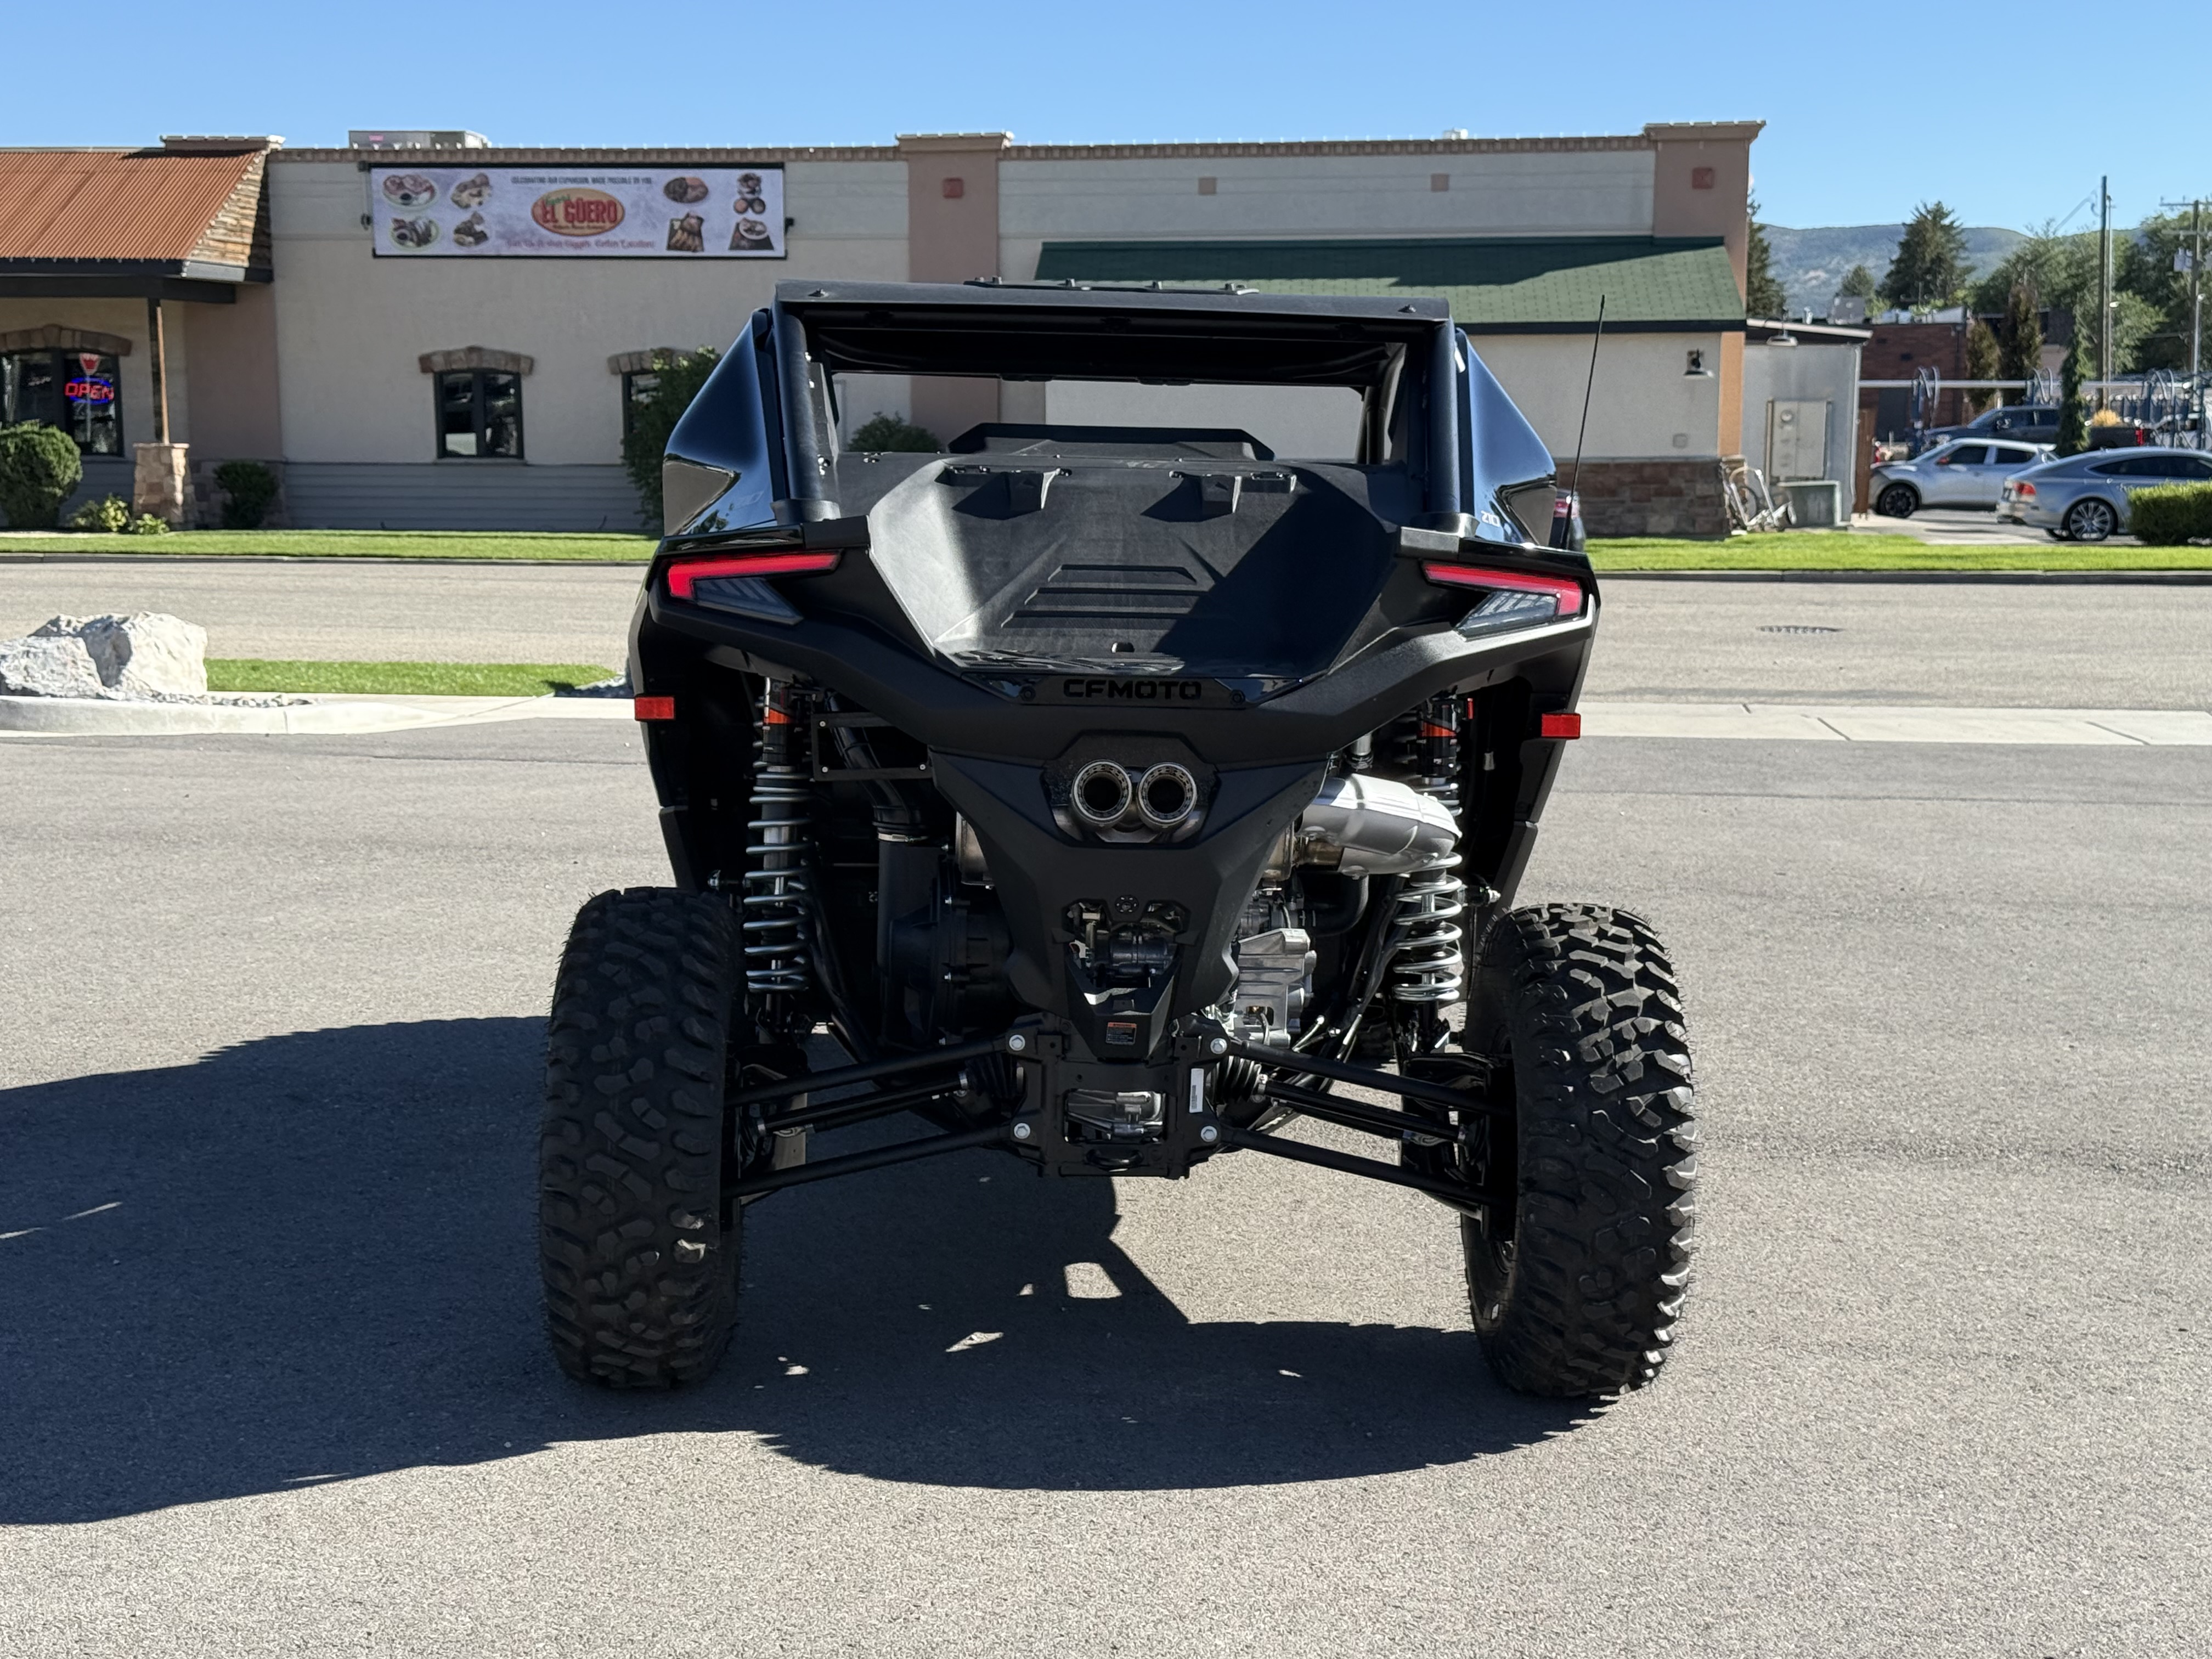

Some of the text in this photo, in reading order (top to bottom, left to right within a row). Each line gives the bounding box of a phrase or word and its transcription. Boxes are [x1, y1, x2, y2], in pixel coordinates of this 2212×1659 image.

[541, 199, 558, 223] EL
[65, 382, 114, 400] OPEN
[1063, 679, 1202, 700] CFMOTO
